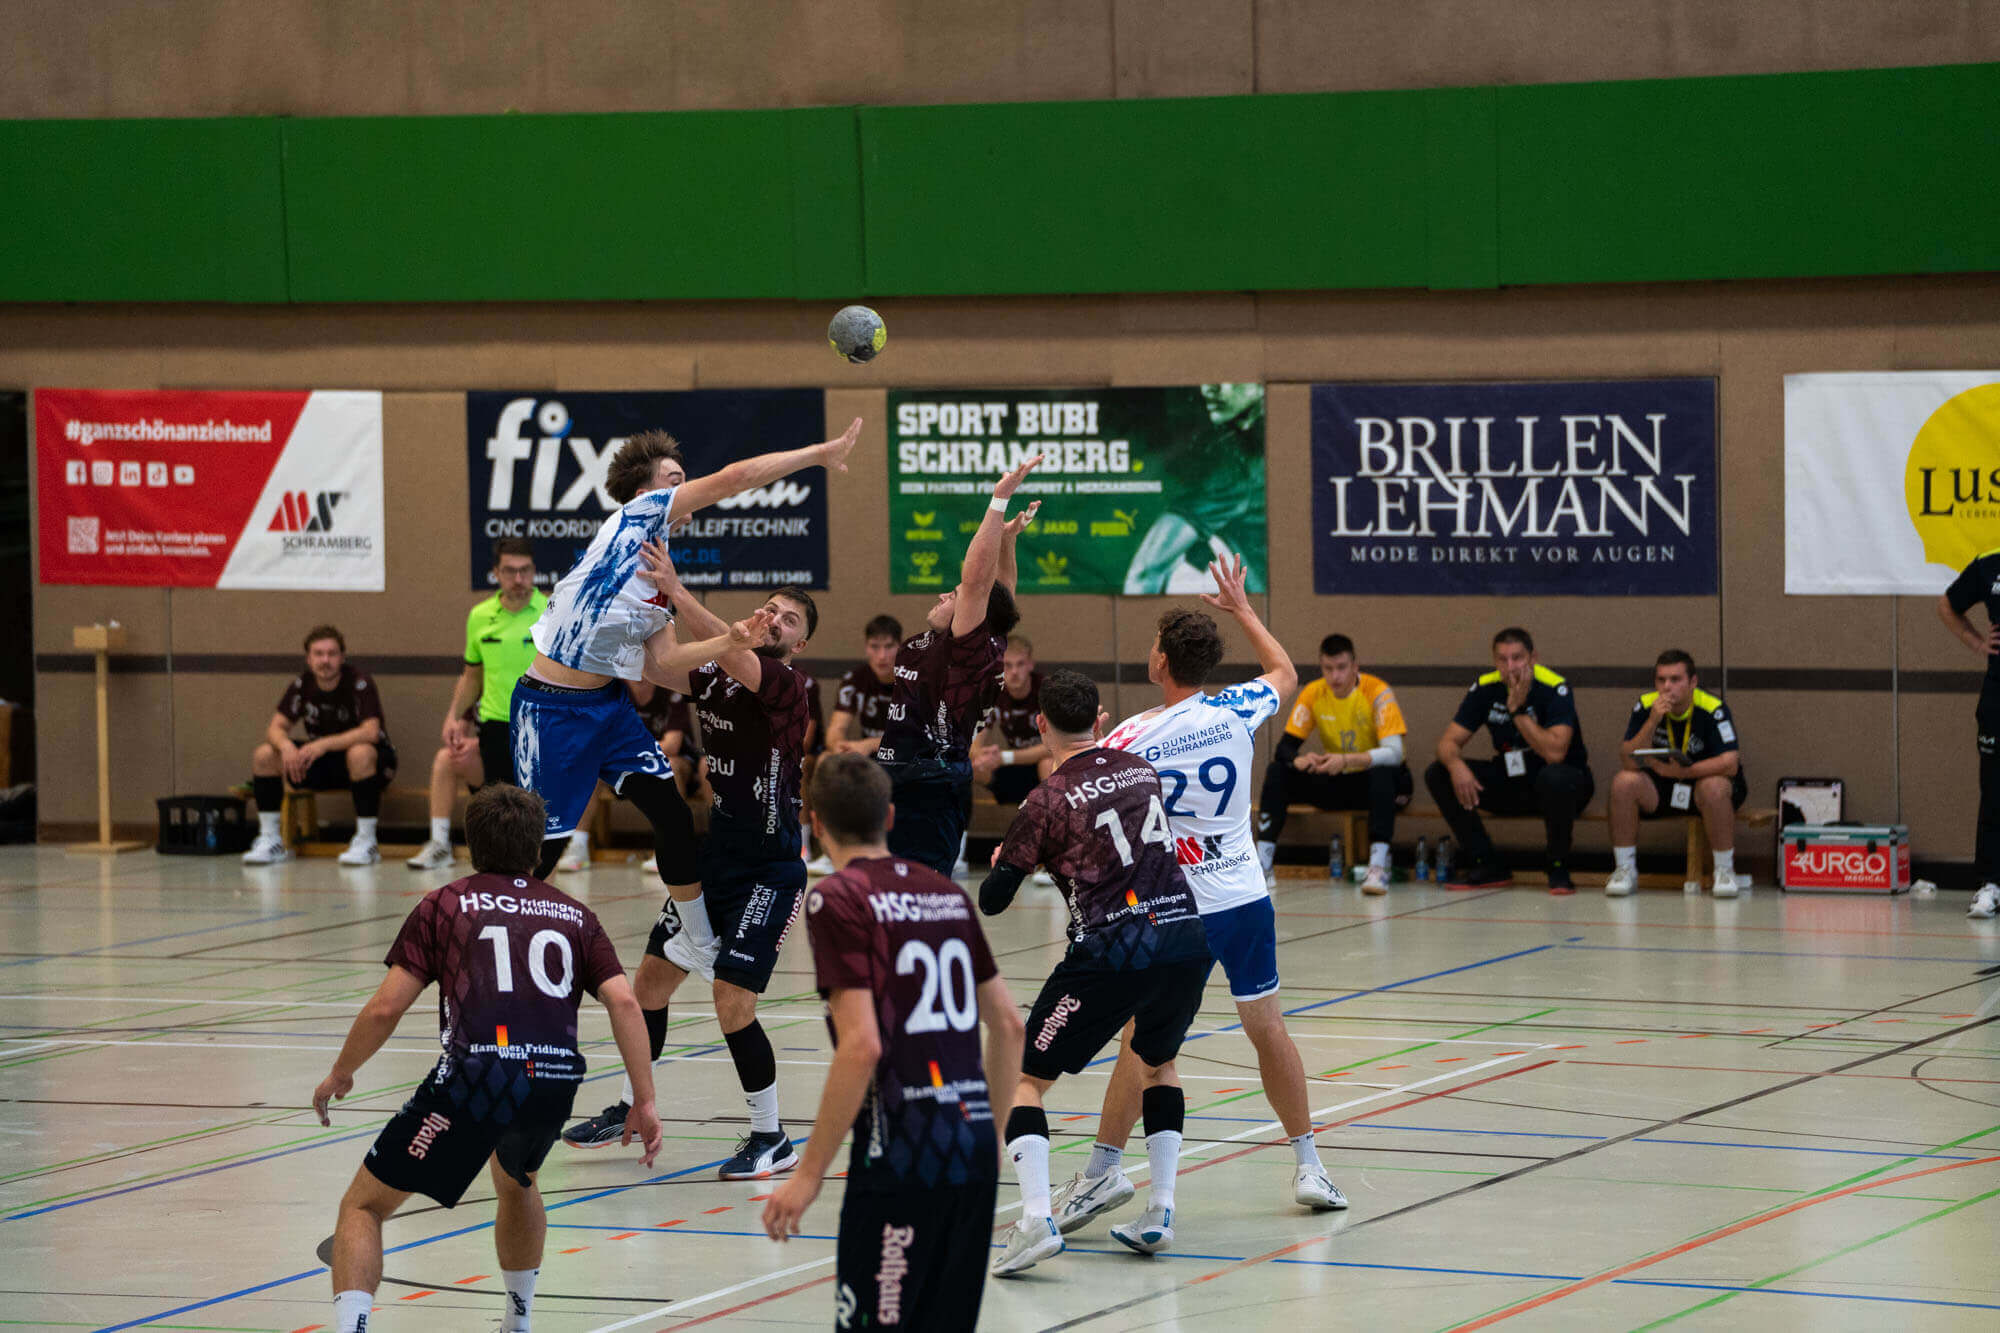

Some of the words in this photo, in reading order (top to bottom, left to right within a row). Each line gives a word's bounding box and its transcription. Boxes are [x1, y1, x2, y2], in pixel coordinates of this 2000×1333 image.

[66, 418, 272, 446] #ganzschönanziehend
[898, 403, 1008, 436] SPORT
[1017, 403, 1099, 435] BUBI
[486, 398, 632, 511] fix
[1356, 414, 1666, 499] BRILLEN
[1330, 475, 1696, 537] LEHMANN
[282, 536, 372, 551] SCHRAMBERG
[486, 519, 524, 538] CNC
[527, 519, 602, 538] KOORDI
[1351, 545, 1419, 562] MODE
[1432, 545, 1518, 562] DIREKT
[1531, 545, 1581, 562] VOR
[1593, 544, 1676, 561] AUGEN
[1136, 746, 1161, 762] G
[1163, 732, 1233, 759] SCHRAMBERG
[1162, 722, 1230, 750] DUNNINGEN
[1065, 776, 1116, 810] HSG
[1159, 756, 1237, 818] 29
[1095, 794, 1173, 868] 14
[1190, 852, 1250, 876] SCHRAMBERG
[1843, 874, 1886, 883] MEDICAL
[460, 893, 519, 913] HSG
[520, 898, 583, 917] Fridingen
[751, 888, 772, 926] BUTSCH
[868, 890, 921, 922] HSG
[478, 925, 574, 999] 10
[896, 938, 978, 1034] 20
[1034, 994, 1081, 1051] Rothaus
[408, 1112, 451, 1160] thaus
[876, 1223, 914, 1324] Rothaus
